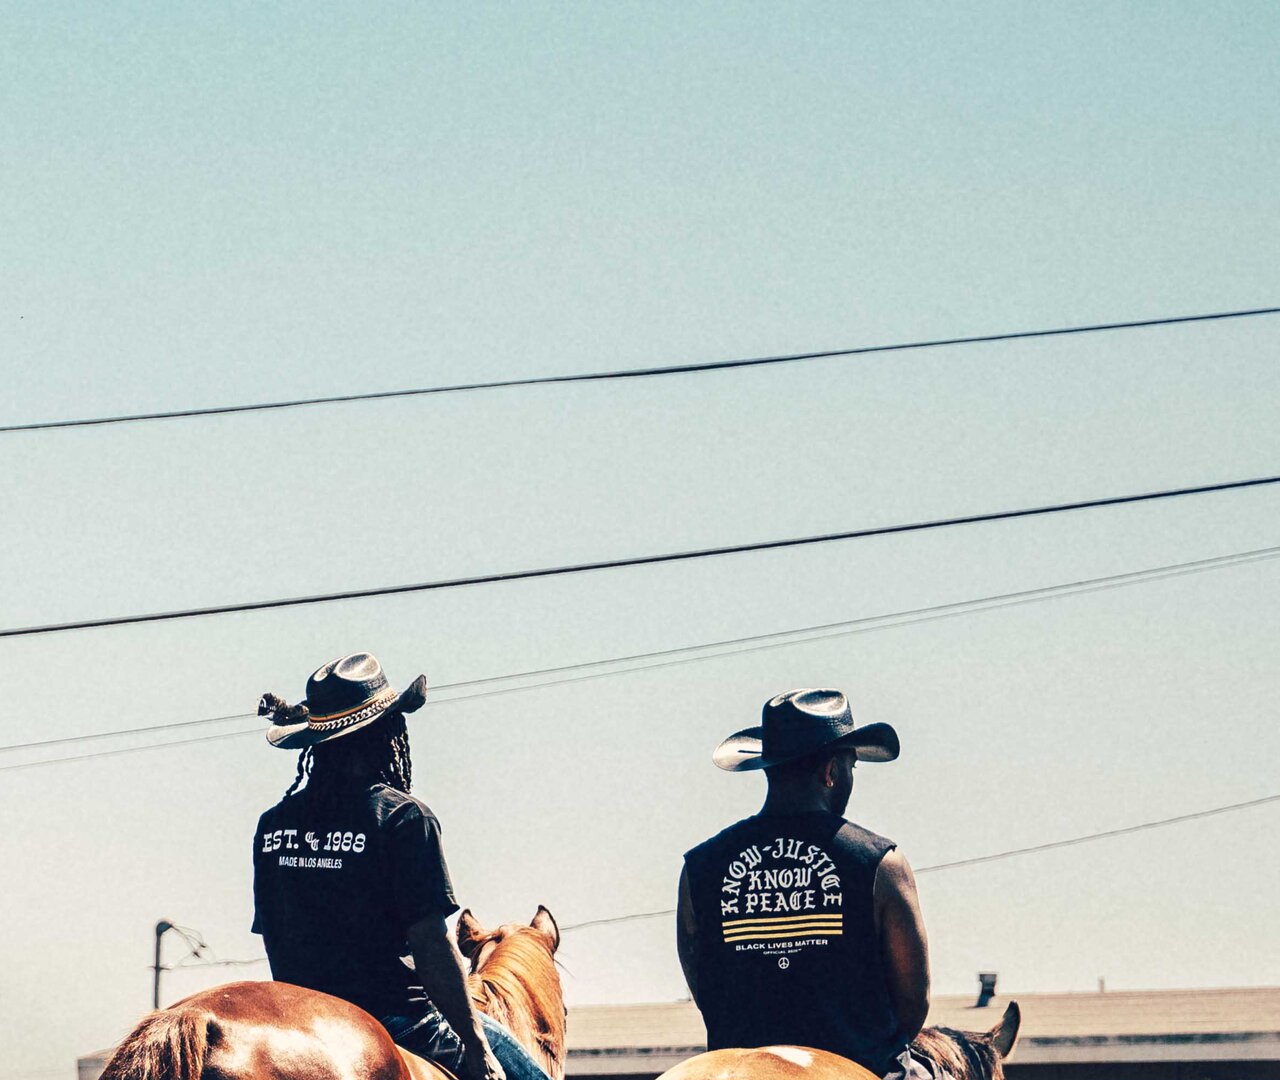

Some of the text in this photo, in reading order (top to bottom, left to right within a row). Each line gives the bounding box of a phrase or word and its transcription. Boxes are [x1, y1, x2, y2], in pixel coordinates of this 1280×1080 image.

[262, 829, 299, 852] EST.
[323, 831, 366, 853] 1988
[278, 856, 342, 869] MADE IN LOS ANGELES
[747, 868, 813, 891] KNOW
[745, 890, 816, 914] PEACE
[735, 939, 828, 951] BLACK LIVES MATTER
